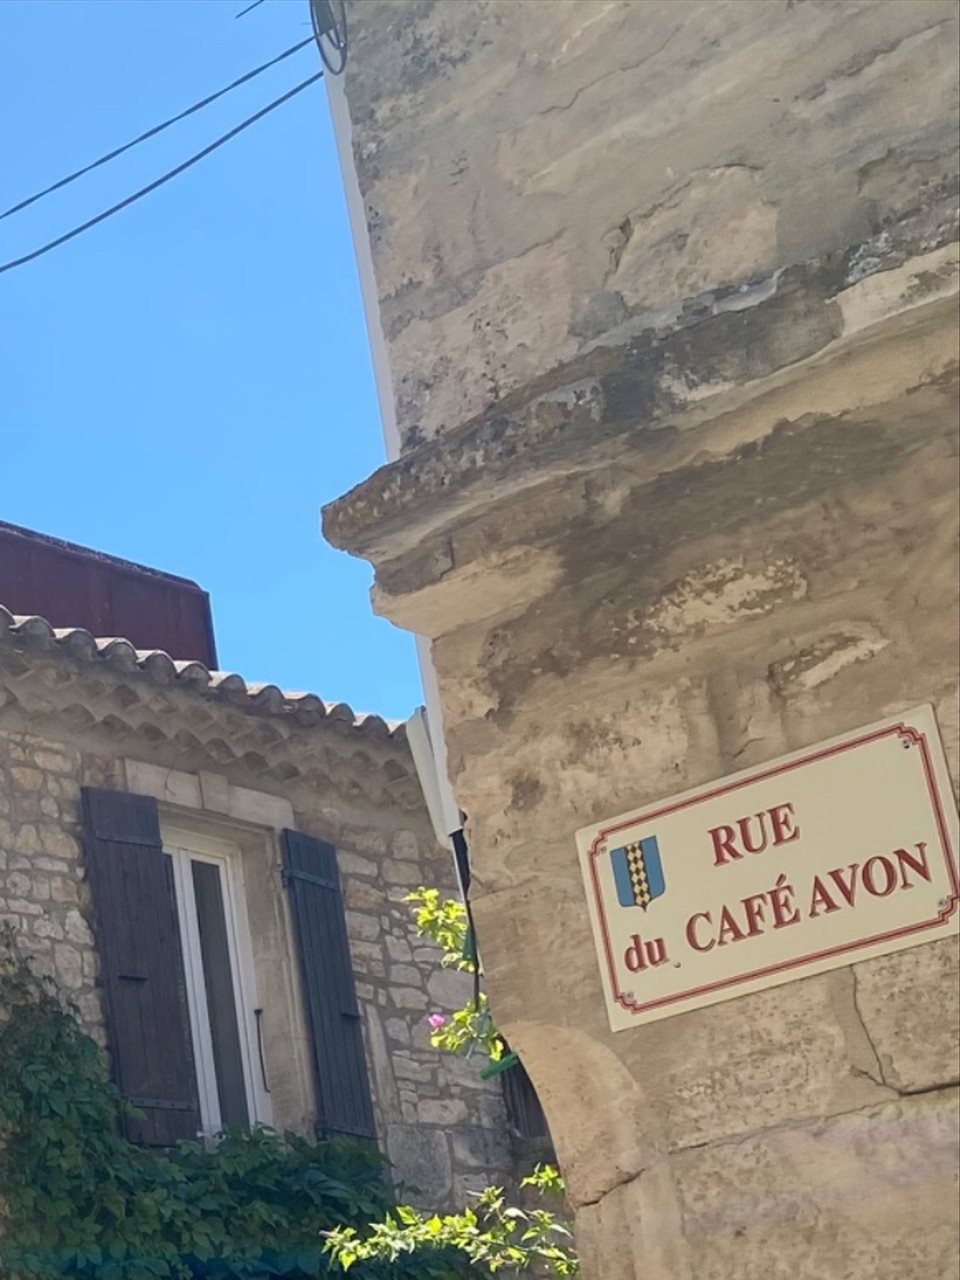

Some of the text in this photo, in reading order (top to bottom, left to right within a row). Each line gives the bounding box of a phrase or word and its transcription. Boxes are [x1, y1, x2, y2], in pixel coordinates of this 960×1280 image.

[707, 802, 800, 867] RUE
[623, 842, 933, 974] du CAFÉ AVON
